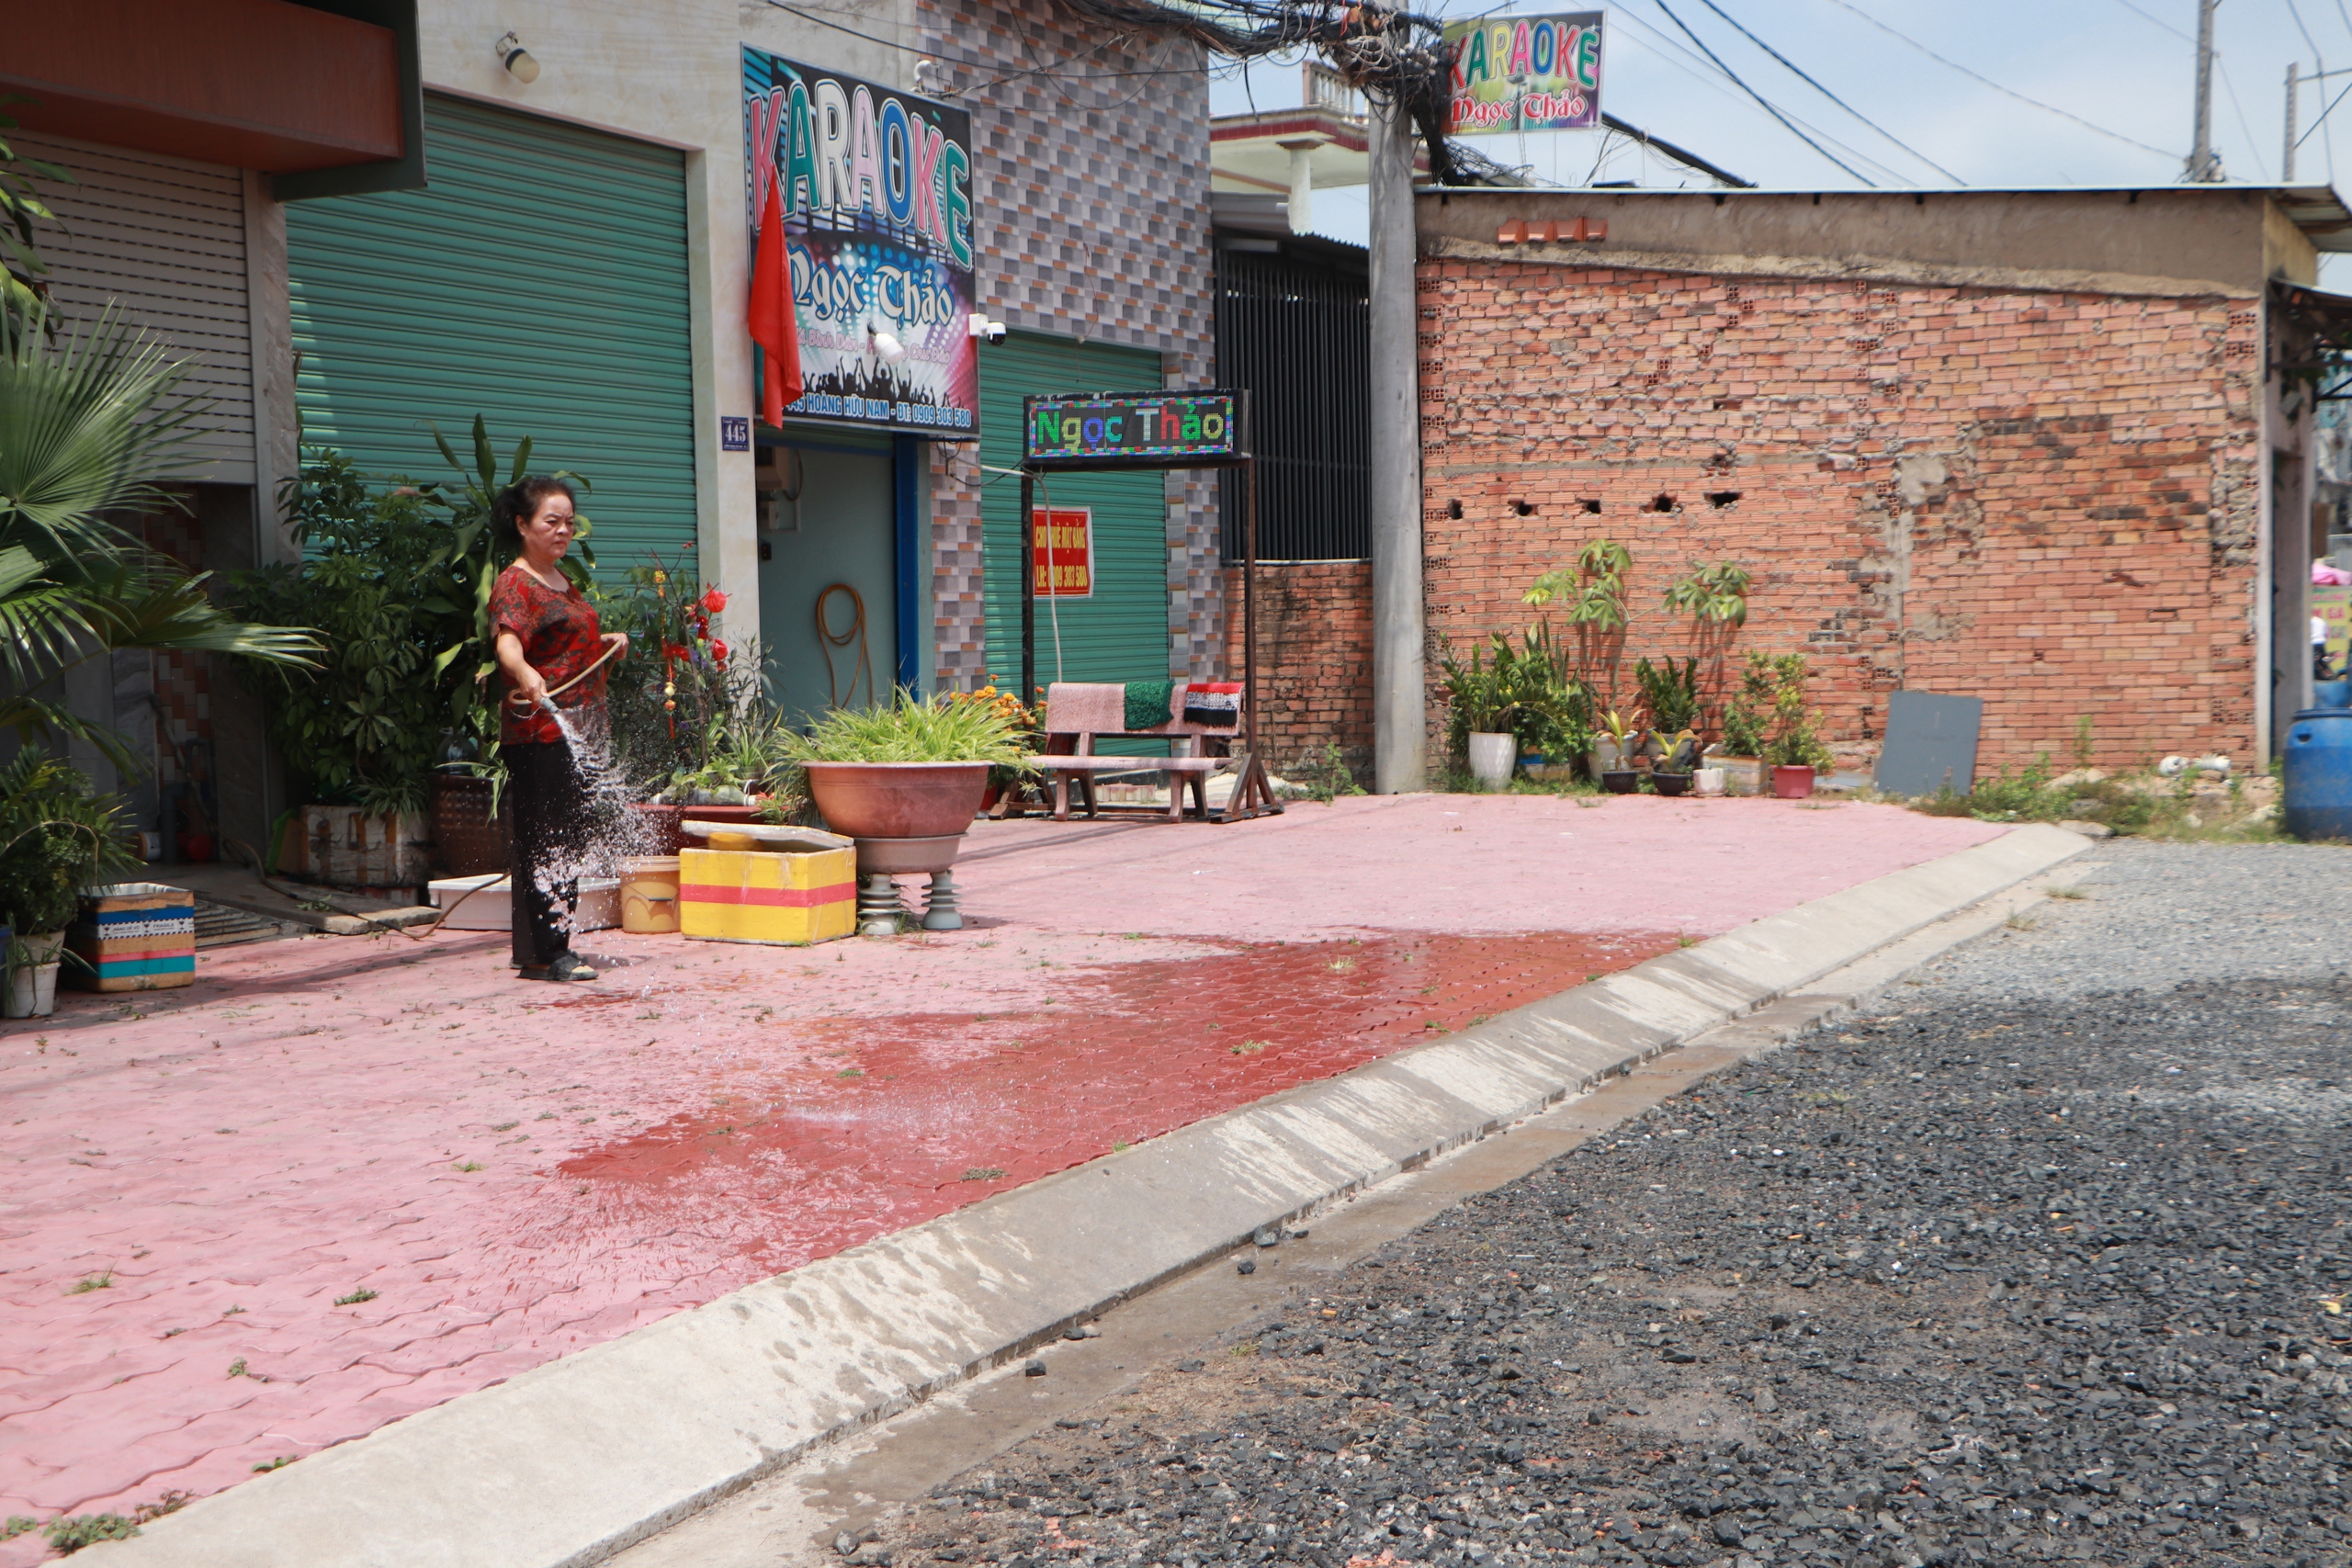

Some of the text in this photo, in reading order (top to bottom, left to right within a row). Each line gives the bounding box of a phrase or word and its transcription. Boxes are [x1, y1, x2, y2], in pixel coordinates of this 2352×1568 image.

[1448, 18, 1600, 93] KARAOKE
[1451, 89, 1589, 128] Ngọc Thảo
[750, 78, 972, 273] KARAOKE
[874, 263, 956, 331] Thảo
[726, 423, 746, 442] 445
[807, 390, 842, 416] HOÀNG
[842, 394, 865, 418] HỮU
[866, 399, 889, 419] NAM
[897, 401, 911, 423] ĐT:
[912, 403, 936, 424] 0909
[936, 407, 953, 426] 303
[955, 409, 972, 428] 580
[1037, 404, 1224, 452] Ngọc Thảo
